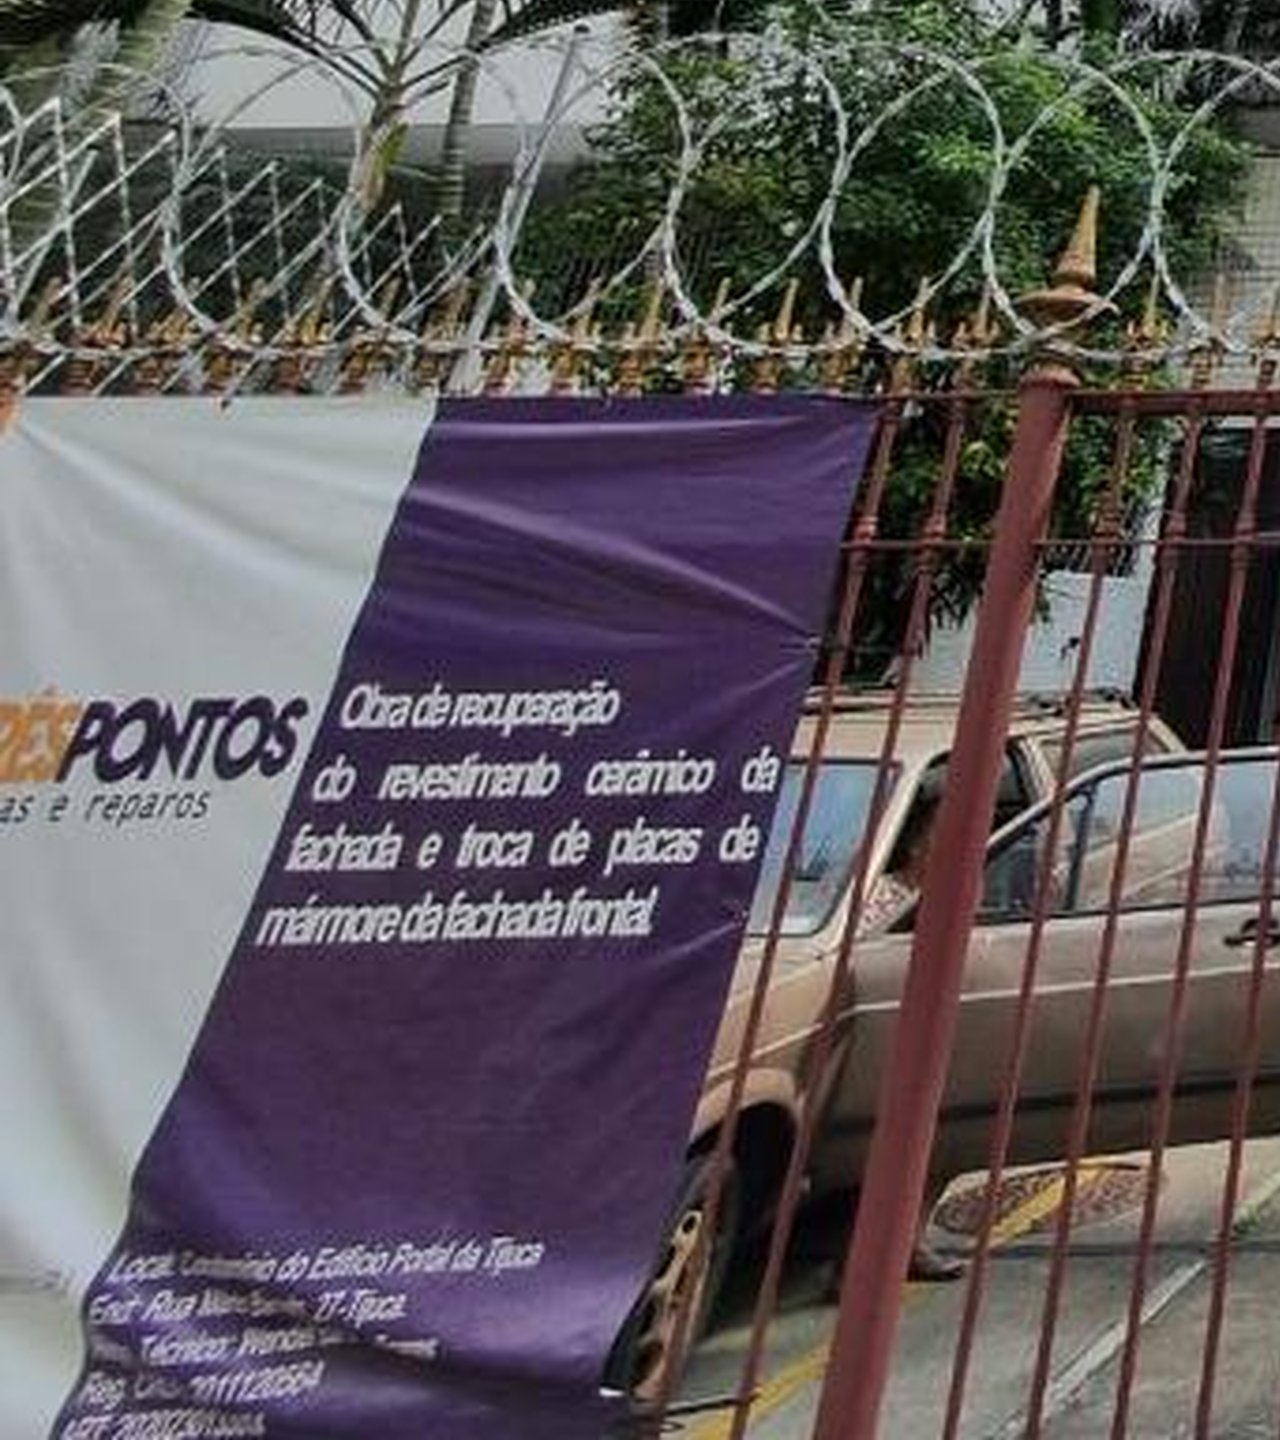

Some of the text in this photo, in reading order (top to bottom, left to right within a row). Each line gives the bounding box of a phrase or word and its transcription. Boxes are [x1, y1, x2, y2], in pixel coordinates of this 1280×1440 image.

[339, 680, 620, 738] Obra de recuperação
[312, 744, 781, 801] do revestimento cerâmico da
[48, 794, 69, 822] e
[85, 790, 210, 827] reparos
[284, 812, 761, 877] fachada e troca de placas de
[254, 894, 402, 946] mármore
[399, 890, 446, 942] da
[441, 887, 567, 940] fachada
